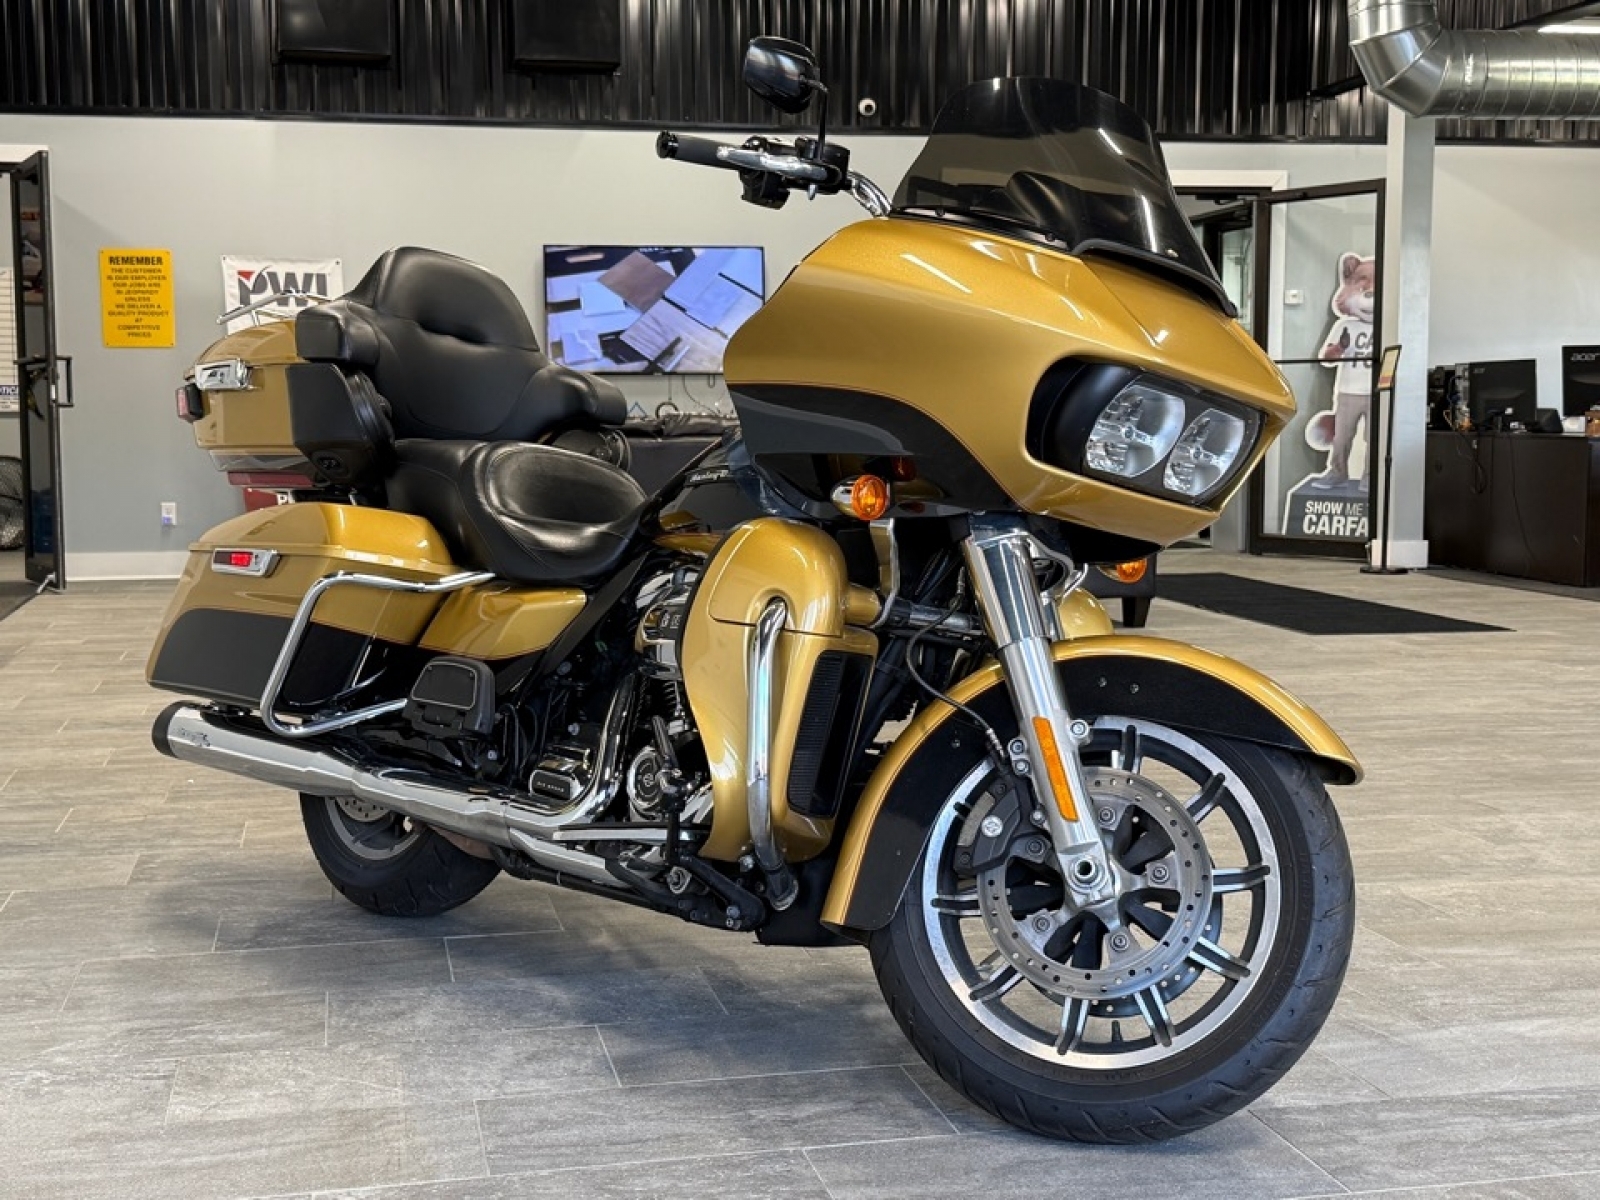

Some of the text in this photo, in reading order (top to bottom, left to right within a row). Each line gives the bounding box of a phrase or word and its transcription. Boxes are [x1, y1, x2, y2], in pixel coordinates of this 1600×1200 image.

[108, 256, 163, 266] REMEMBER
[1304, 500, 1344, 514] SHOW
[1345, 502, 1364, 515] ME
